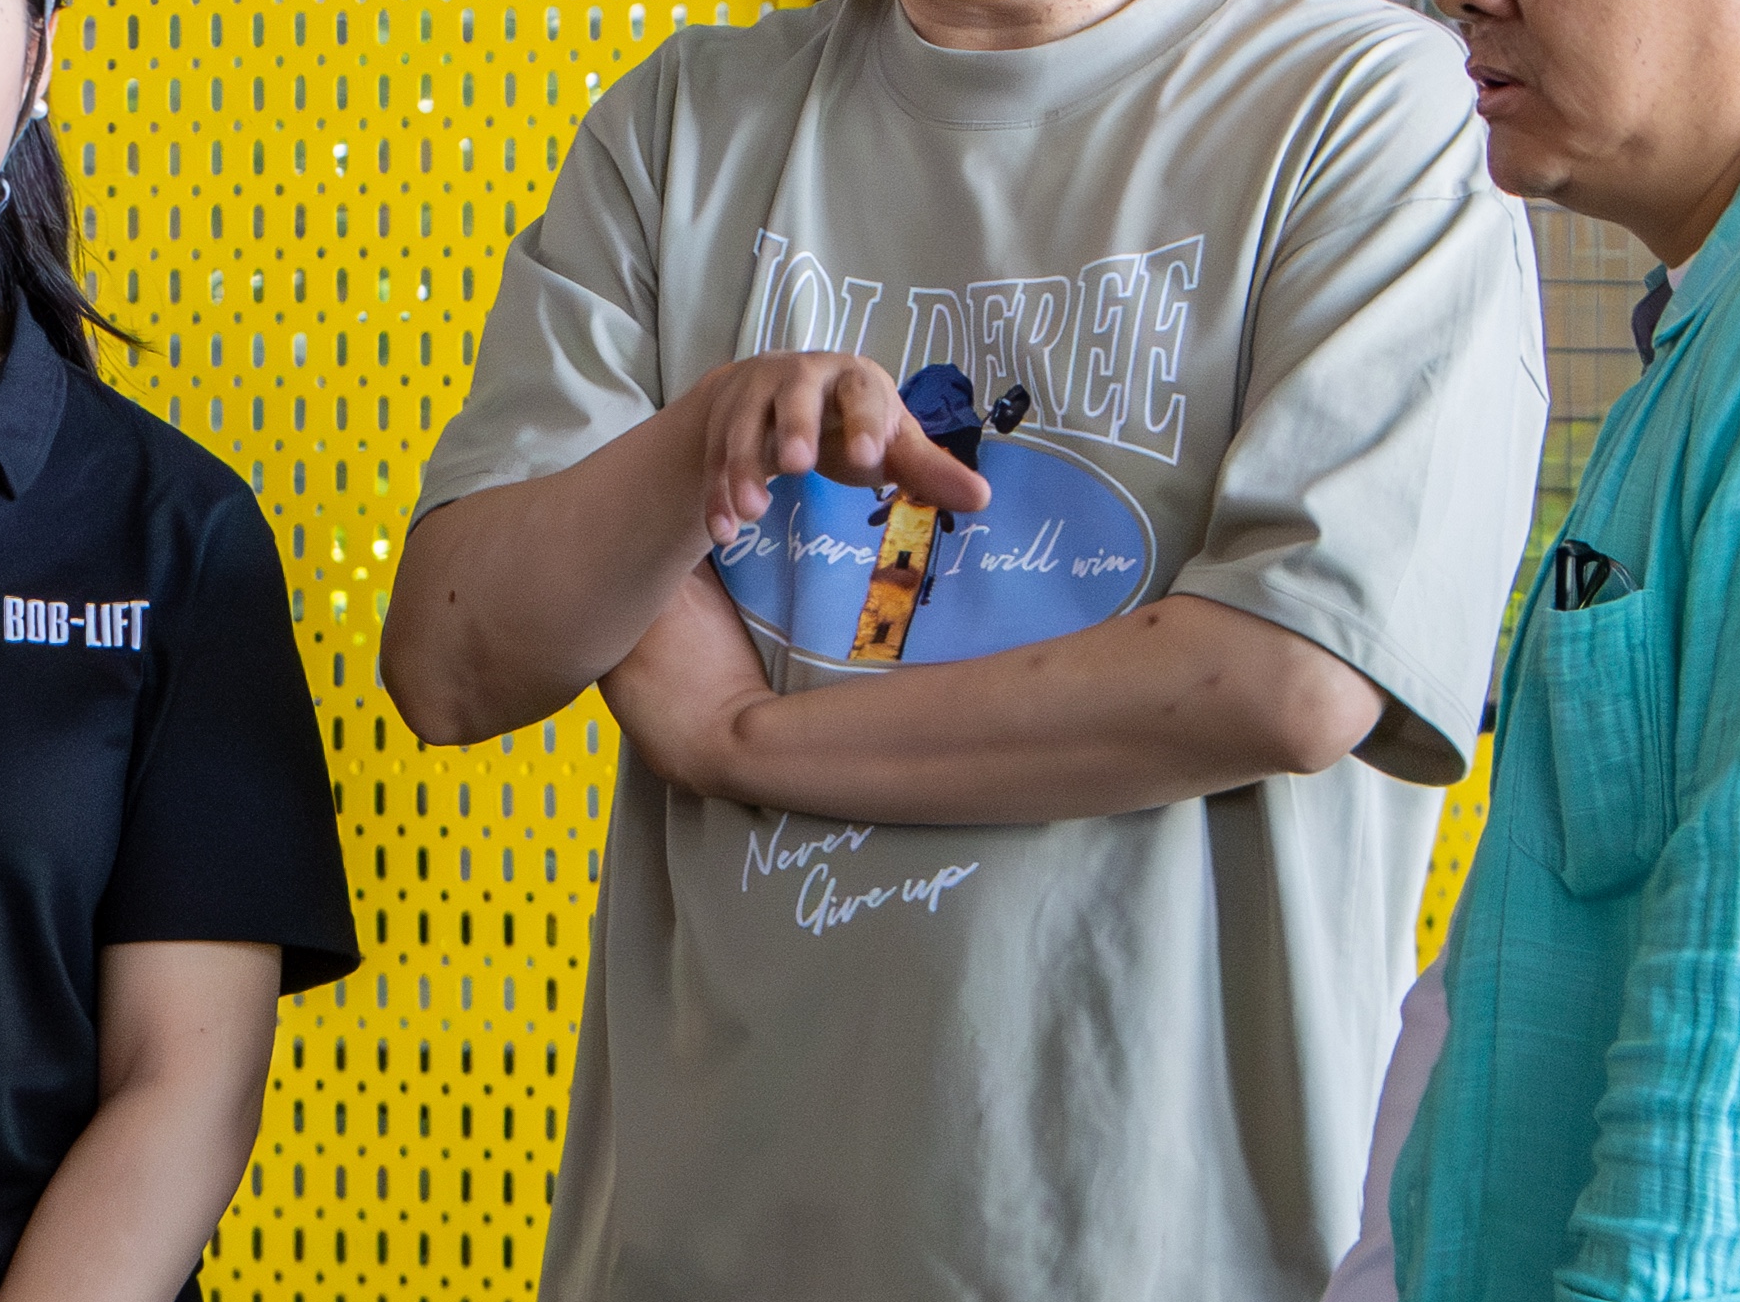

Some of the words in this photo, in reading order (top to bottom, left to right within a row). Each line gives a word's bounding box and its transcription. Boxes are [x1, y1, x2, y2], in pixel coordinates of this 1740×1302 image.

[980, 518, 1060, 572] will
[1071, 547, 1137, 578] win
[3, 595, 151, 651] BOB-LIFT
[741, 811, 875, 893] Never
[902, 861, 980, 913] up
